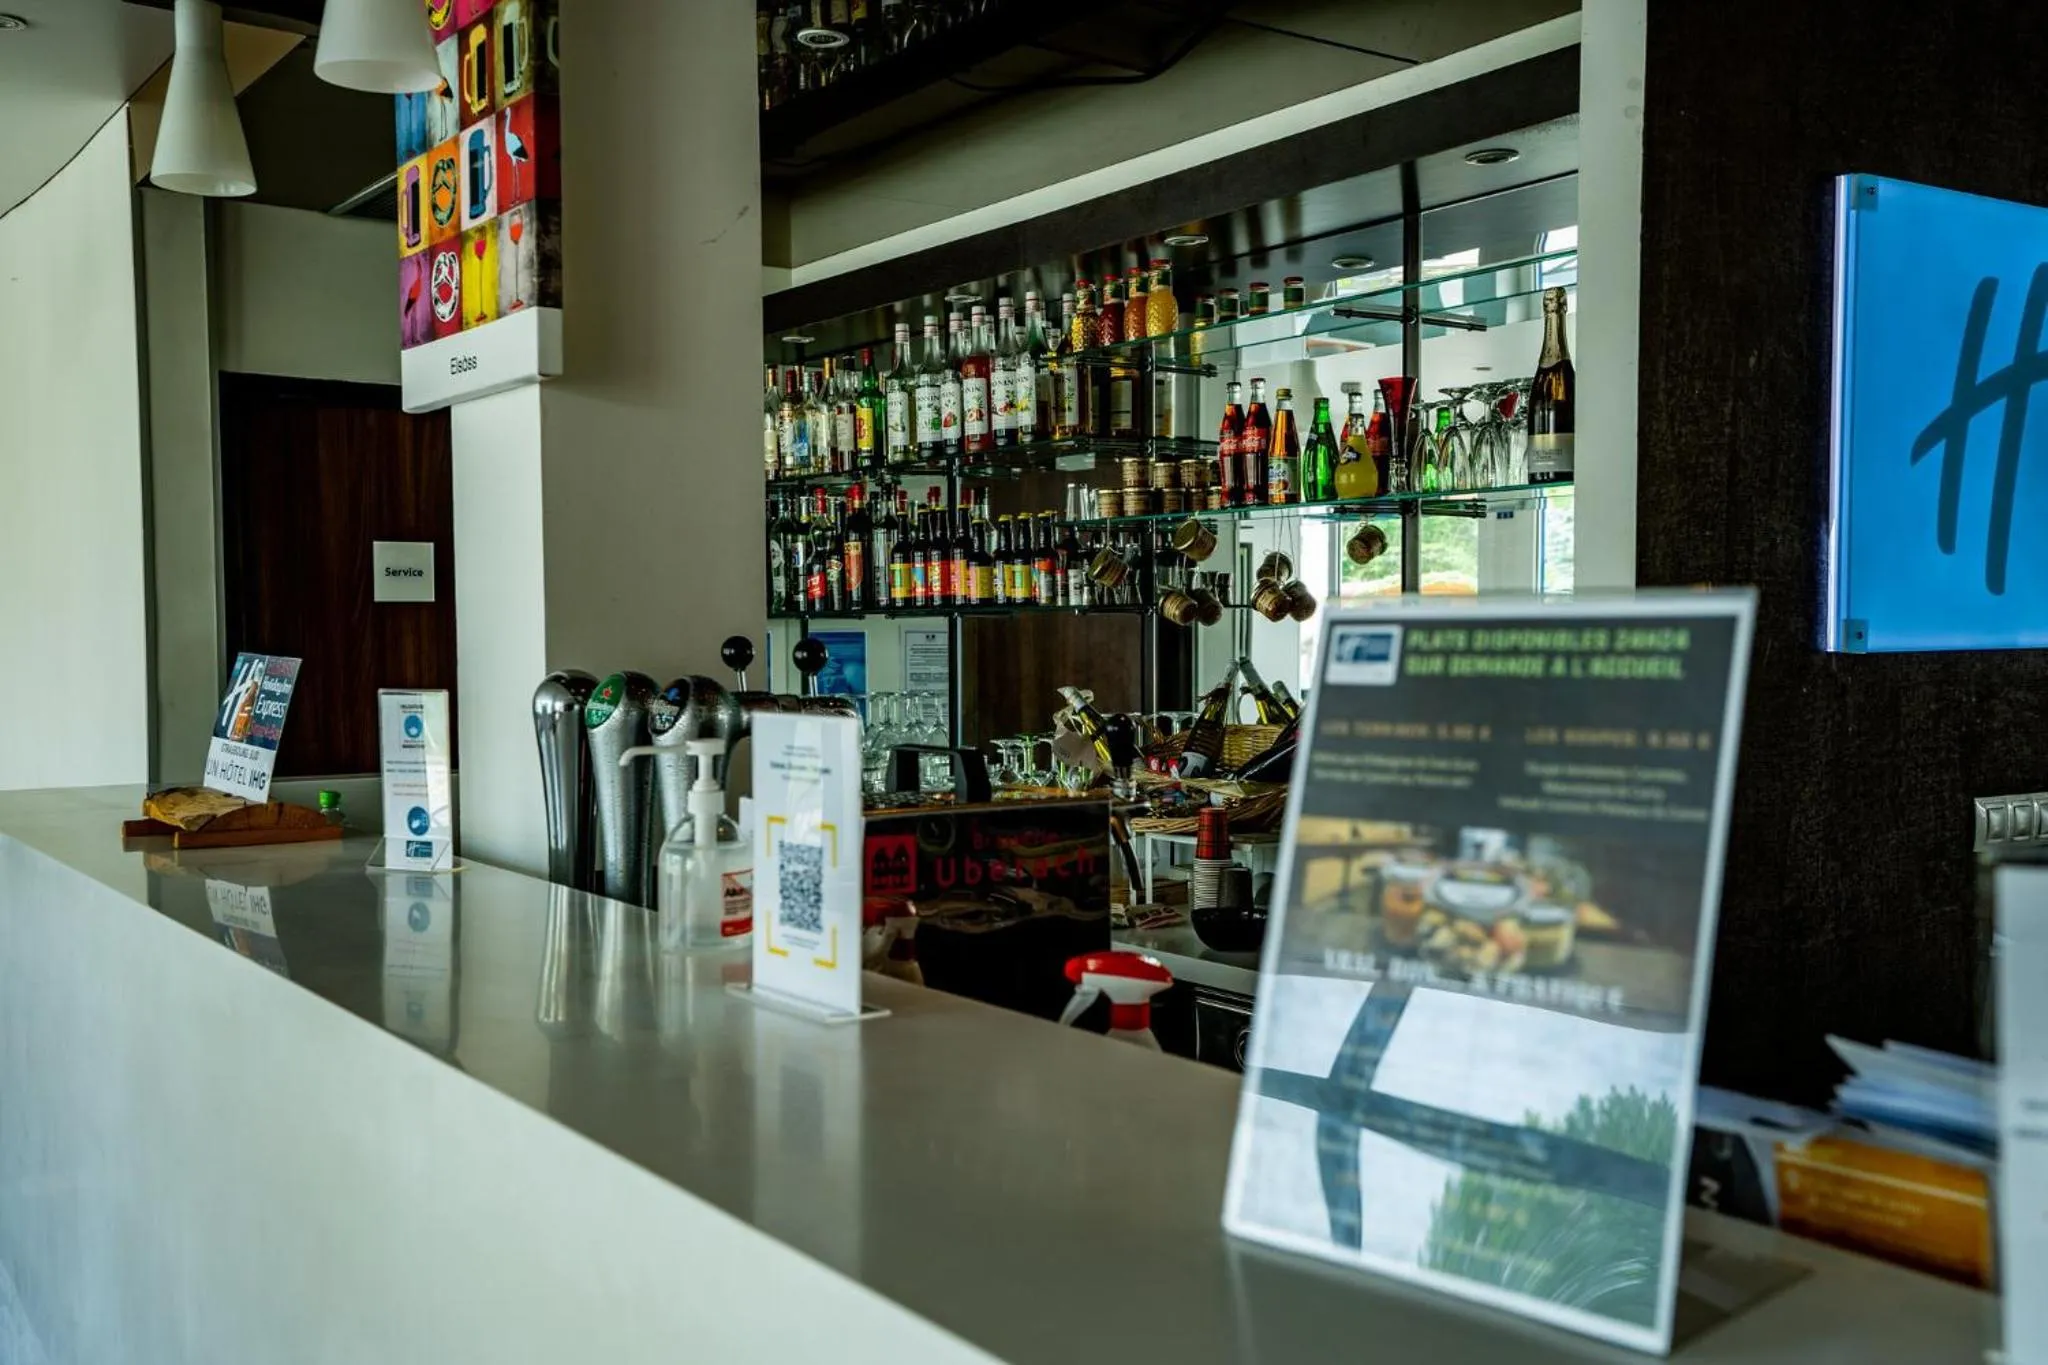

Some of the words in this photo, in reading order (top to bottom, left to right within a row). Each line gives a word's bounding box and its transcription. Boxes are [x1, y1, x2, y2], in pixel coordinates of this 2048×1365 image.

[384, 567, 424, 577] Service
[255, 694, 288, 719] Express
[247, 768, 267, 791] IHG
